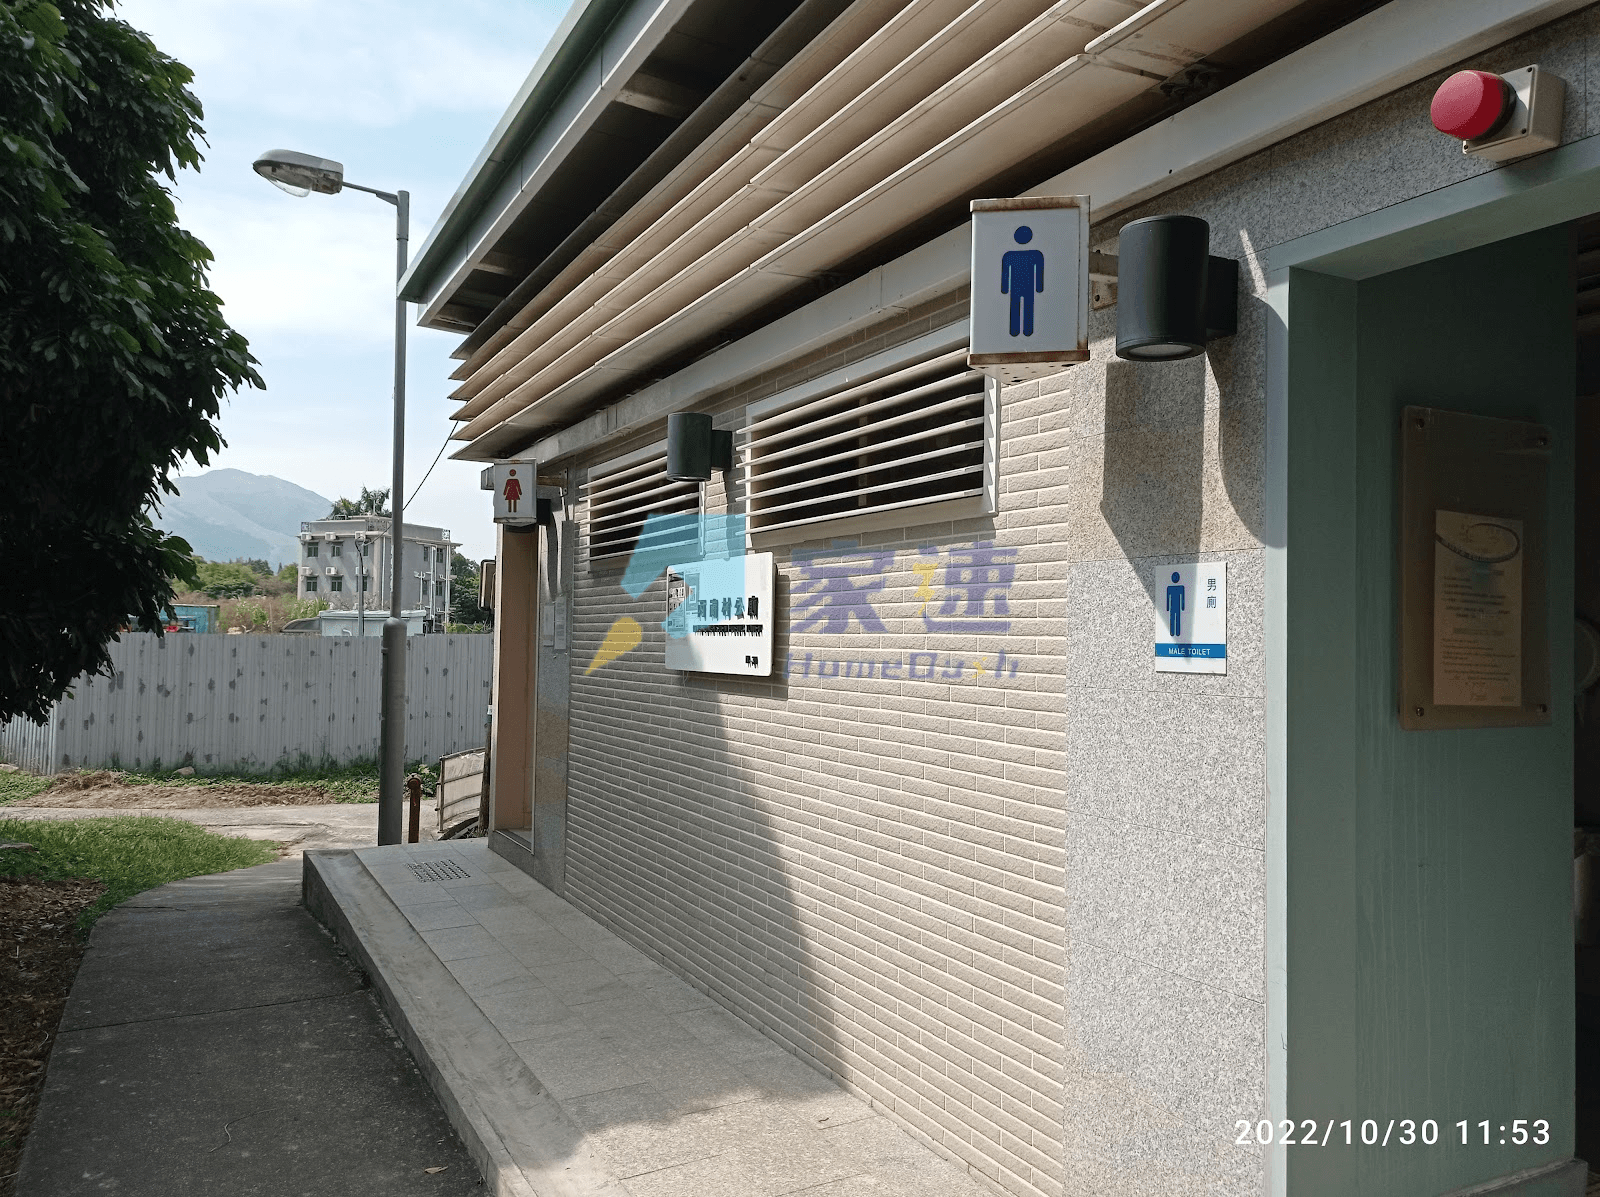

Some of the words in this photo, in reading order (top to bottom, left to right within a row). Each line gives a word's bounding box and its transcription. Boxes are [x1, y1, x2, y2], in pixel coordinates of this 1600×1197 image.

[1207, 579, 1216, 608] 男廁
[1168, 647, 1185, 655] MALE
[1188, 648, 1211, 656] TOILET
